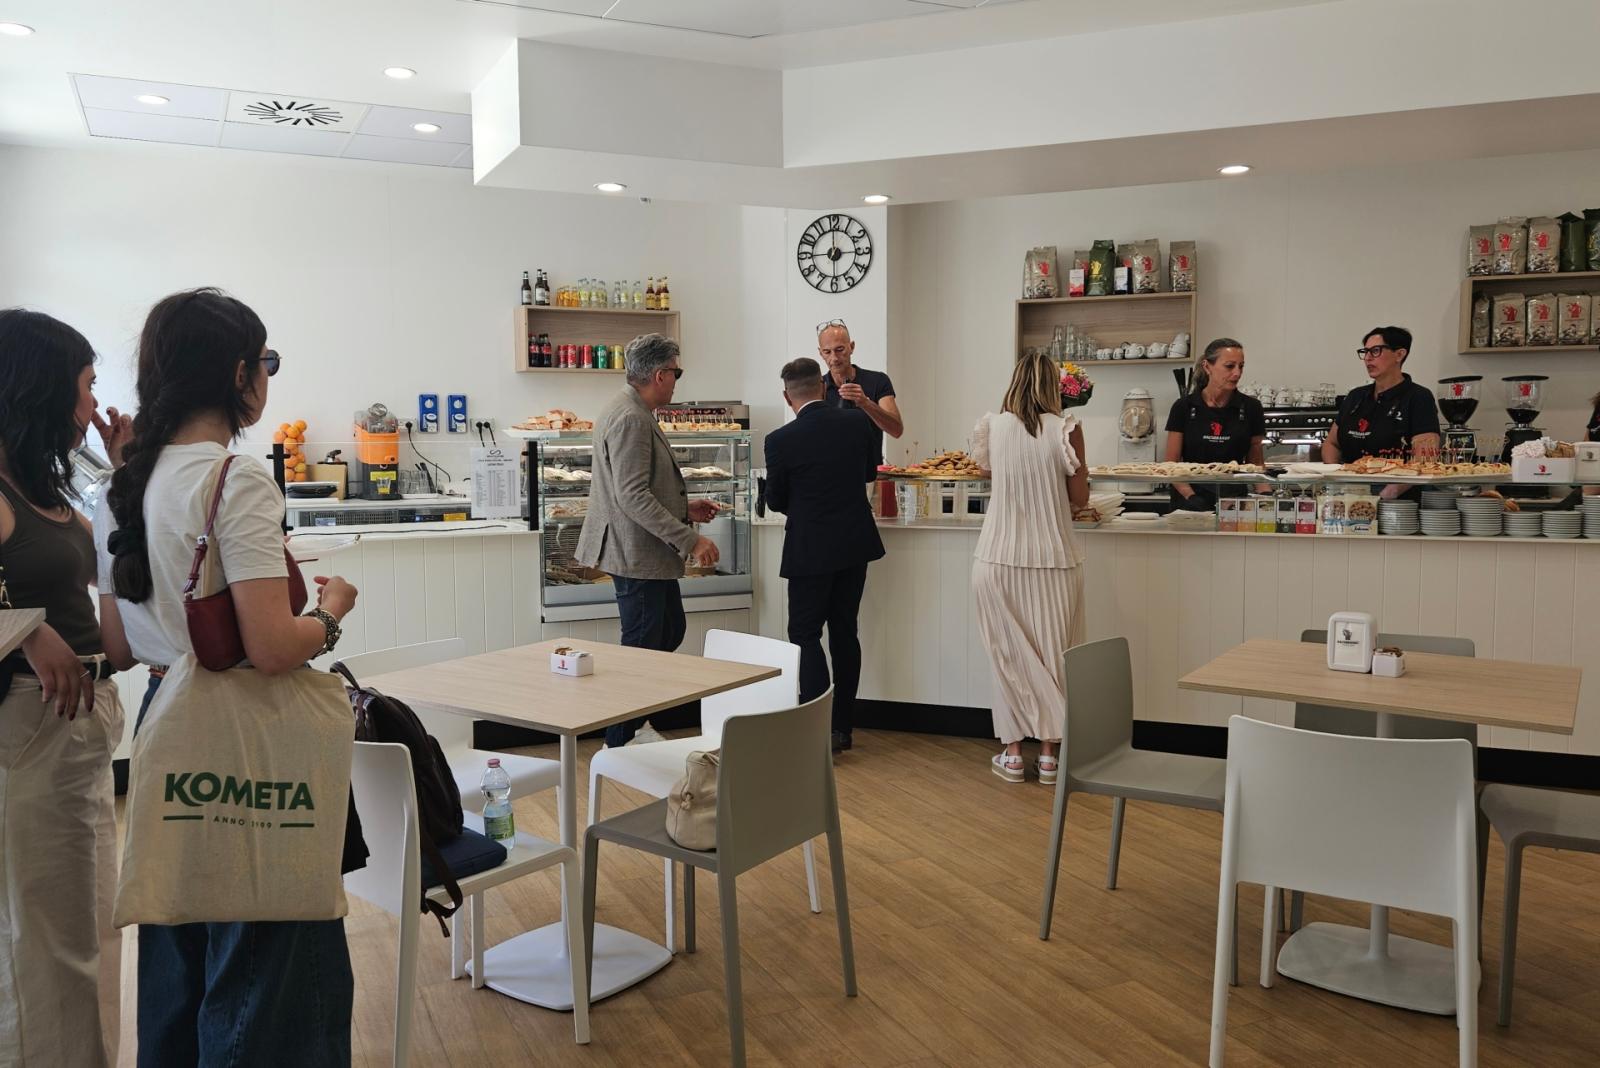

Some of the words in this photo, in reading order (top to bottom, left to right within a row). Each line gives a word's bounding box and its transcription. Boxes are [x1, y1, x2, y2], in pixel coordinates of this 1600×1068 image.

[825, 214, 840, 231] 12
[844, 217, 853, 233] 1
[799, 232, 816, 250] 10
[850, 228, 867, 244] 2
[798, 251, 813, 261] 9
[854, 246, 872, 256] 3
[802, 264, 816, 277] 8
[853, 261, 869, 274] 4
[815, 273, 827, 289] 7
[830, 276, 839, 293] 6
[842, 272, 855, 287] 5
[164, 771, 315, 811] KOMETA
[213, 815, 246, 827] ANNO
